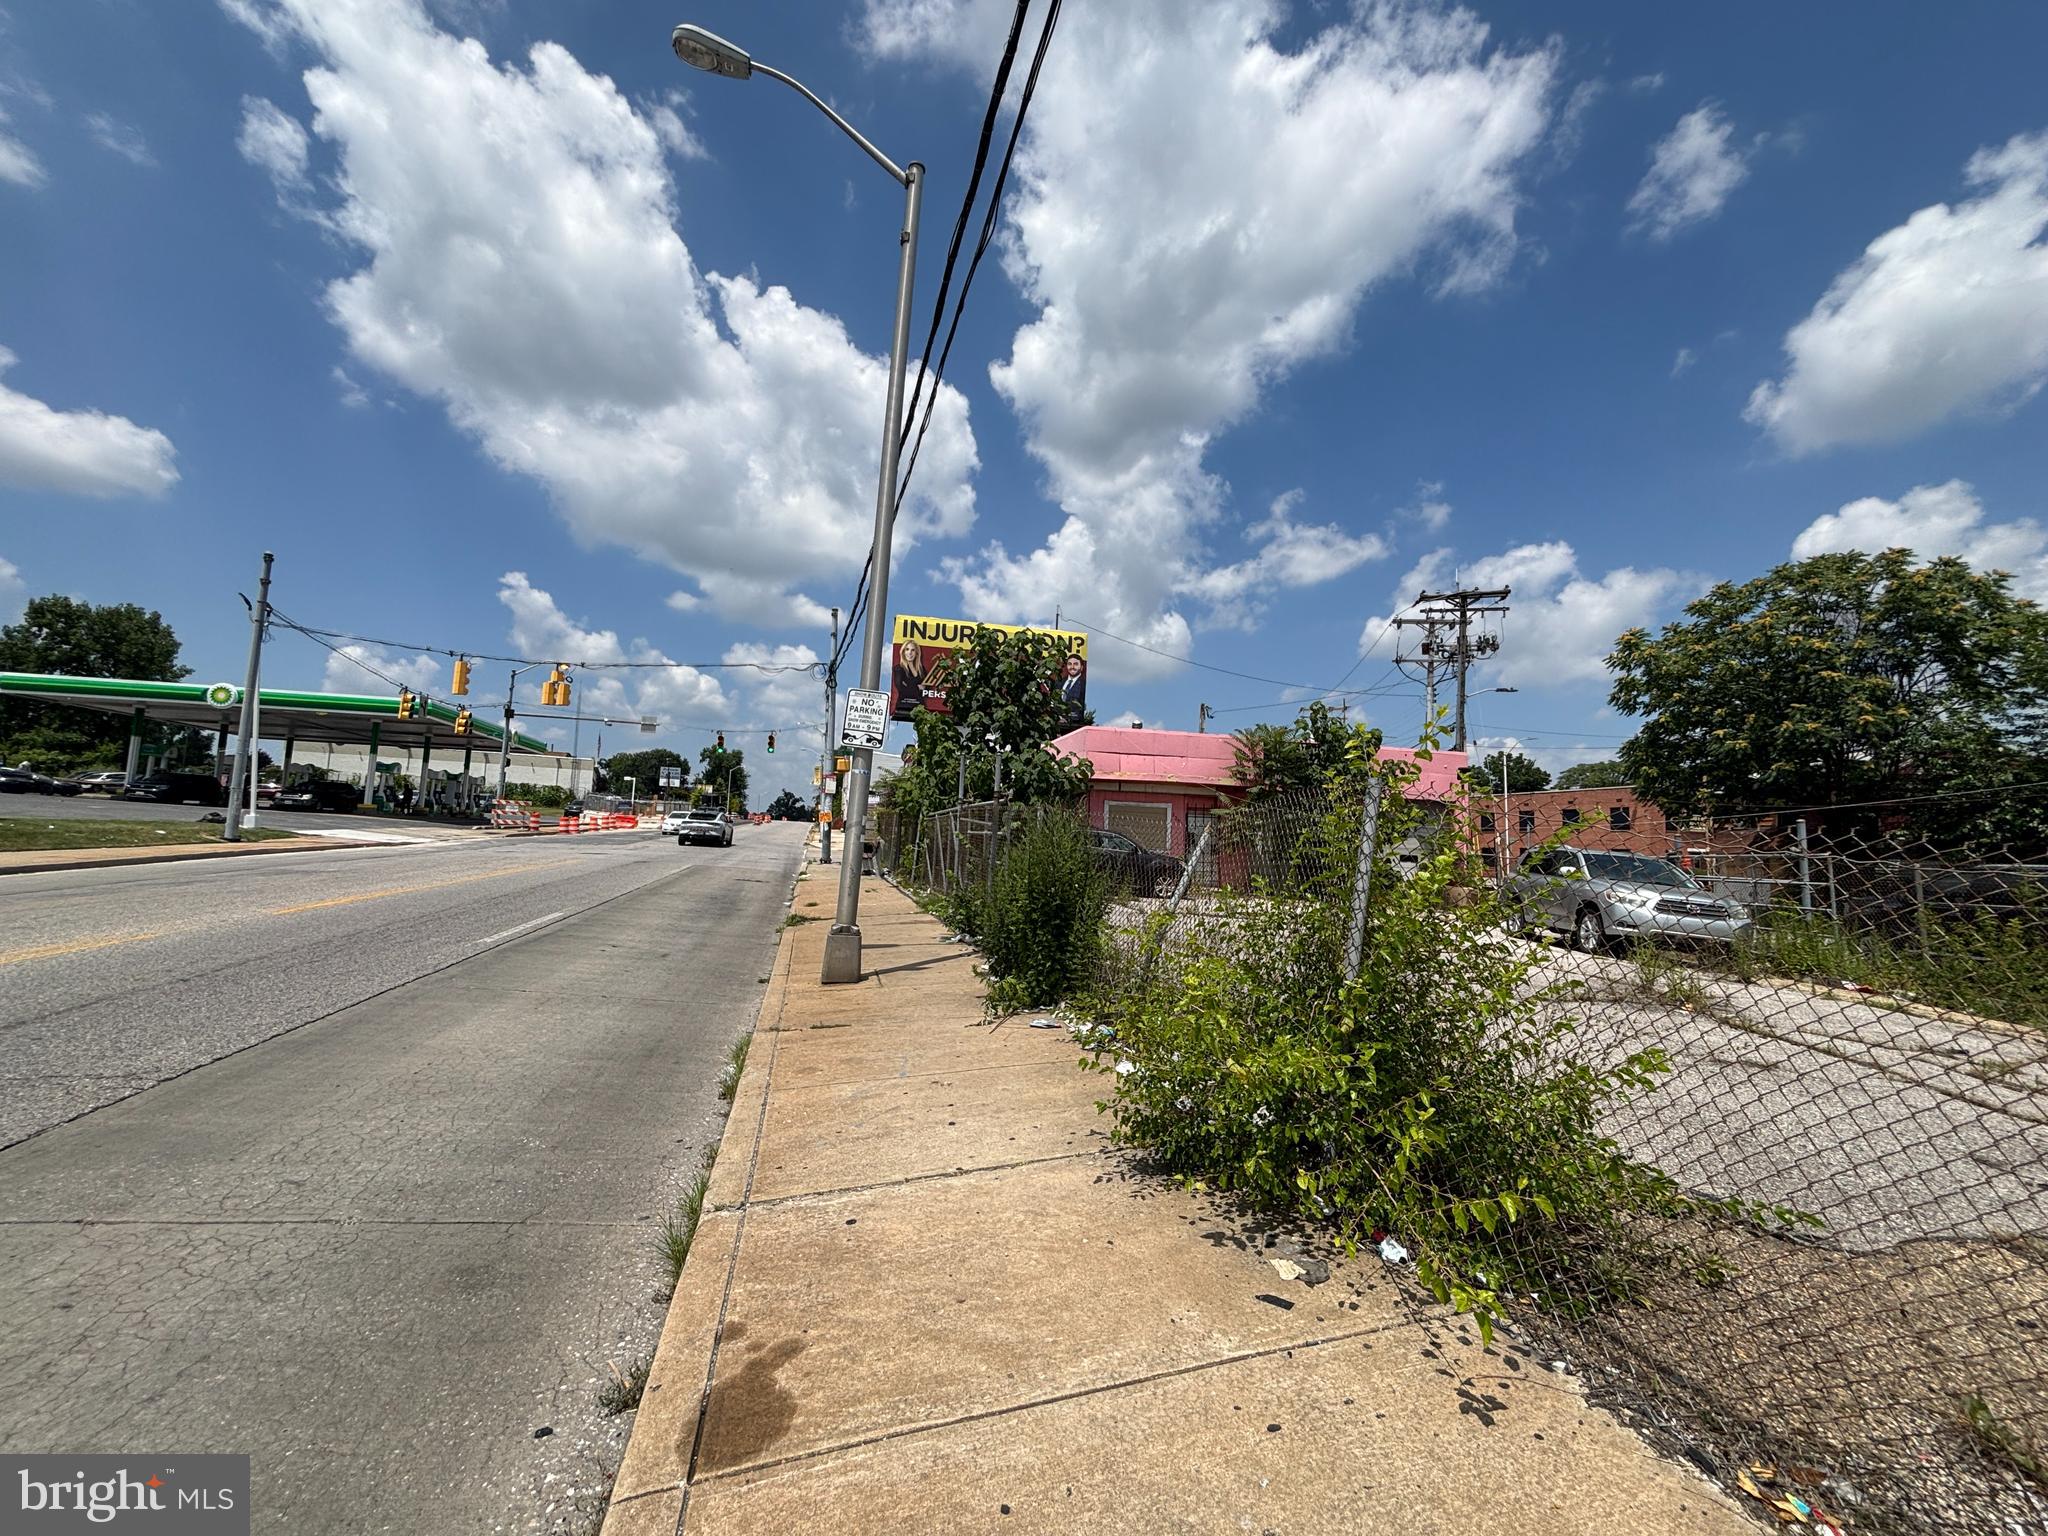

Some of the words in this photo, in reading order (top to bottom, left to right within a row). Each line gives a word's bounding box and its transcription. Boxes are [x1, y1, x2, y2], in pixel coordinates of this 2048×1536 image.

[903, 619, 1008, 649] INJURD
[861, 698, 875, 707] NO
[849, 705, 883, 716] PARKING
